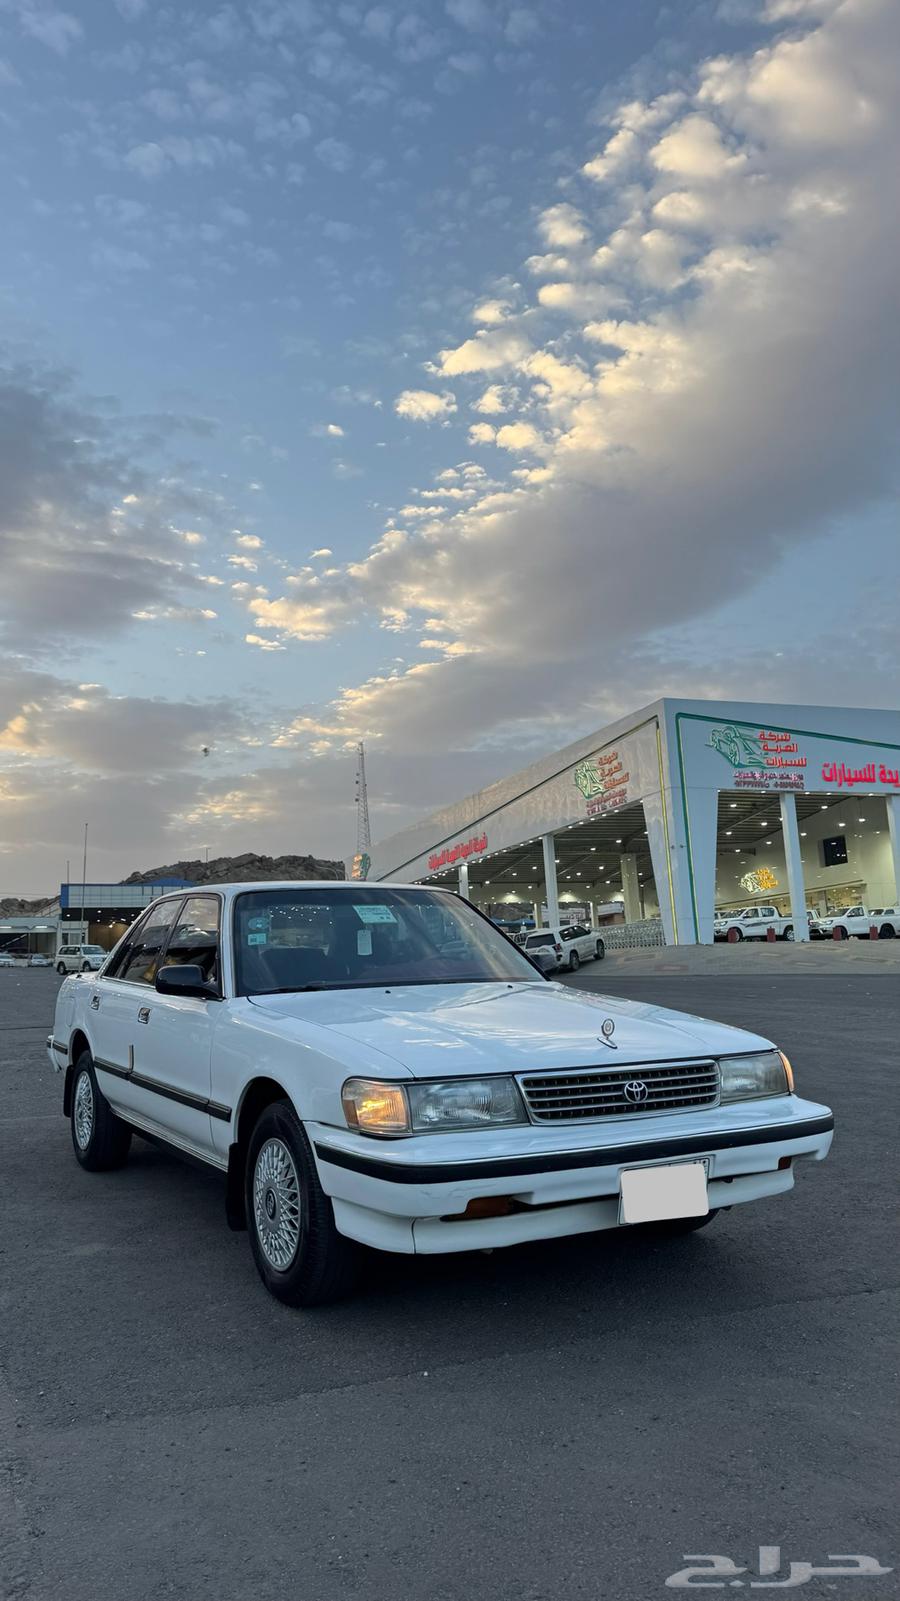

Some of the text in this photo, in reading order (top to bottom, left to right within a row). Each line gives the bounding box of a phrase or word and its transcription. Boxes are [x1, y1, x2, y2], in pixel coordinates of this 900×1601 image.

[758, 730, 791, 744] شركة
[765, 756, 807, 769] للسيارات
[821, 762, 876, 788] للسيارات
